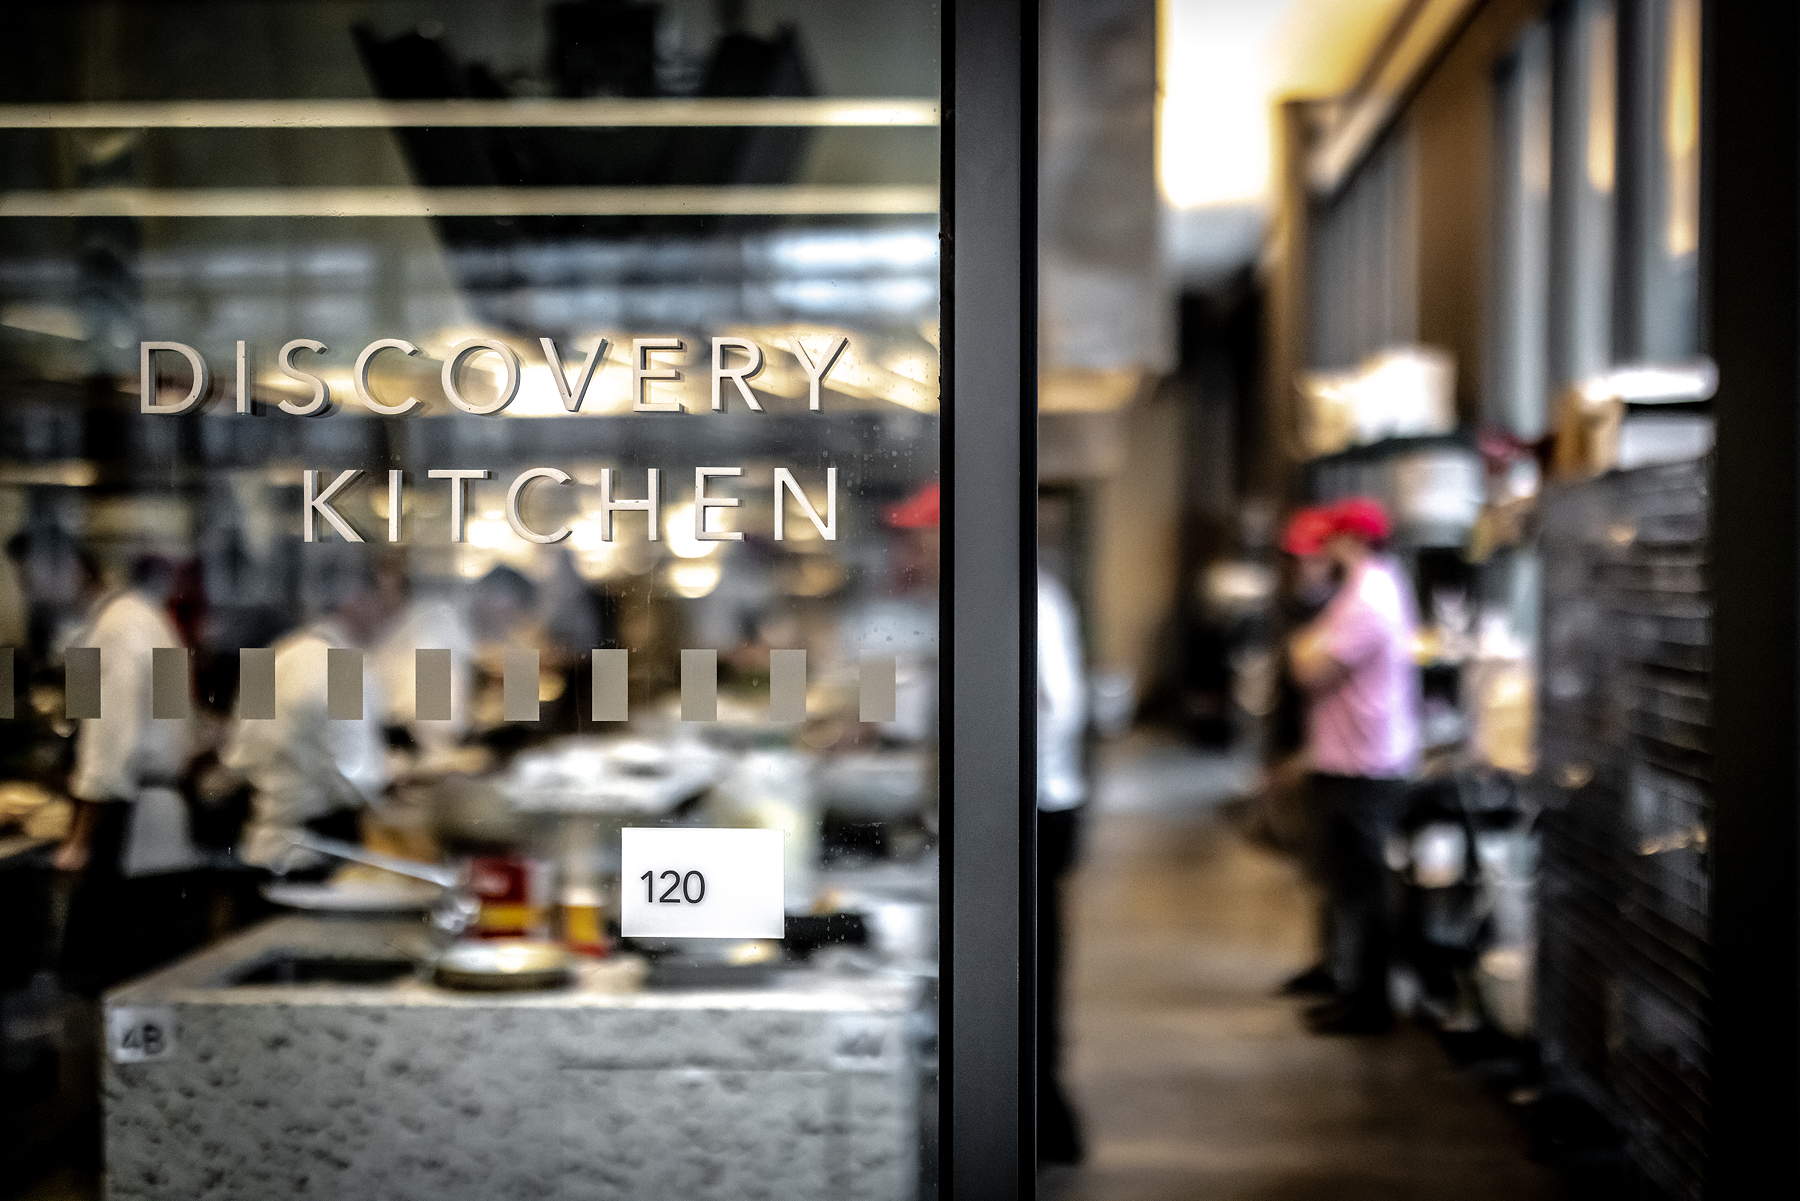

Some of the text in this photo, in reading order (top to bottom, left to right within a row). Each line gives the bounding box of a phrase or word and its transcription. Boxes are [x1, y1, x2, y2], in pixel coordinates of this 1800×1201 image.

[139, 337, 849, 416] DISCOVERY
[303, 467, 839, 543] KITCHEN
[640, 870, 705, 904] 120
